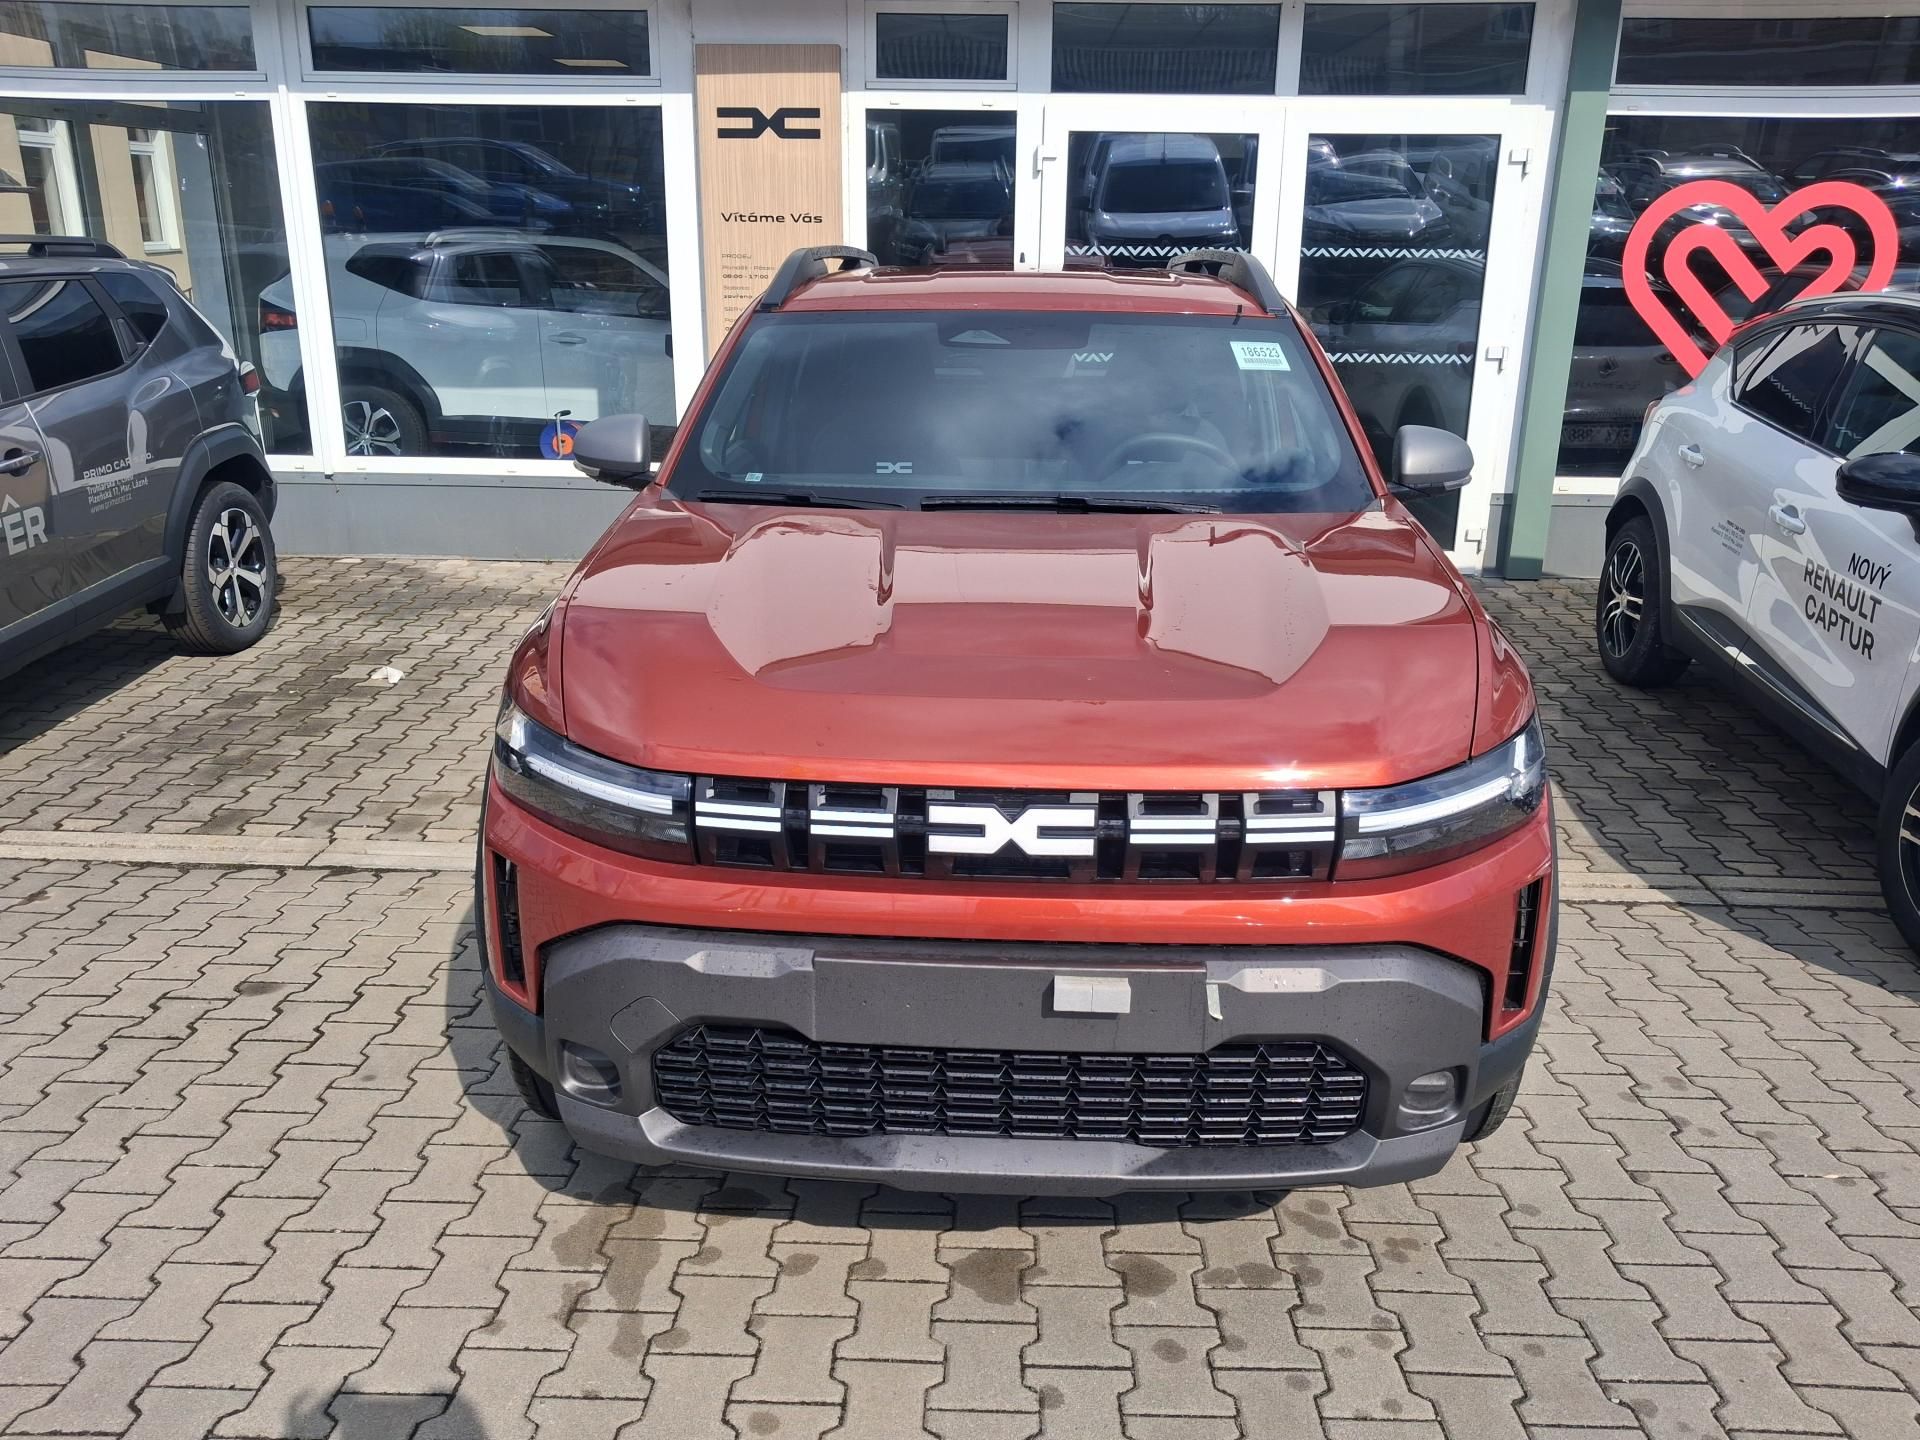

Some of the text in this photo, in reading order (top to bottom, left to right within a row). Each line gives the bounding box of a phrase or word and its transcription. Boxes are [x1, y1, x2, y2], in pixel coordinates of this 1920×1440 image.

[721, 212, 823, 224] Vítáme Vás
[1240, 346, 1280, 358] 186523
[83, 463, 112, 480] PRIMO
[0, 506, 49, 556] ER
[1848, 552, 1892, 590] NOVÝ
[1804, 557, 1882, 624] RENAULT
[1805, 594, 1875, 660] CAPTUR
